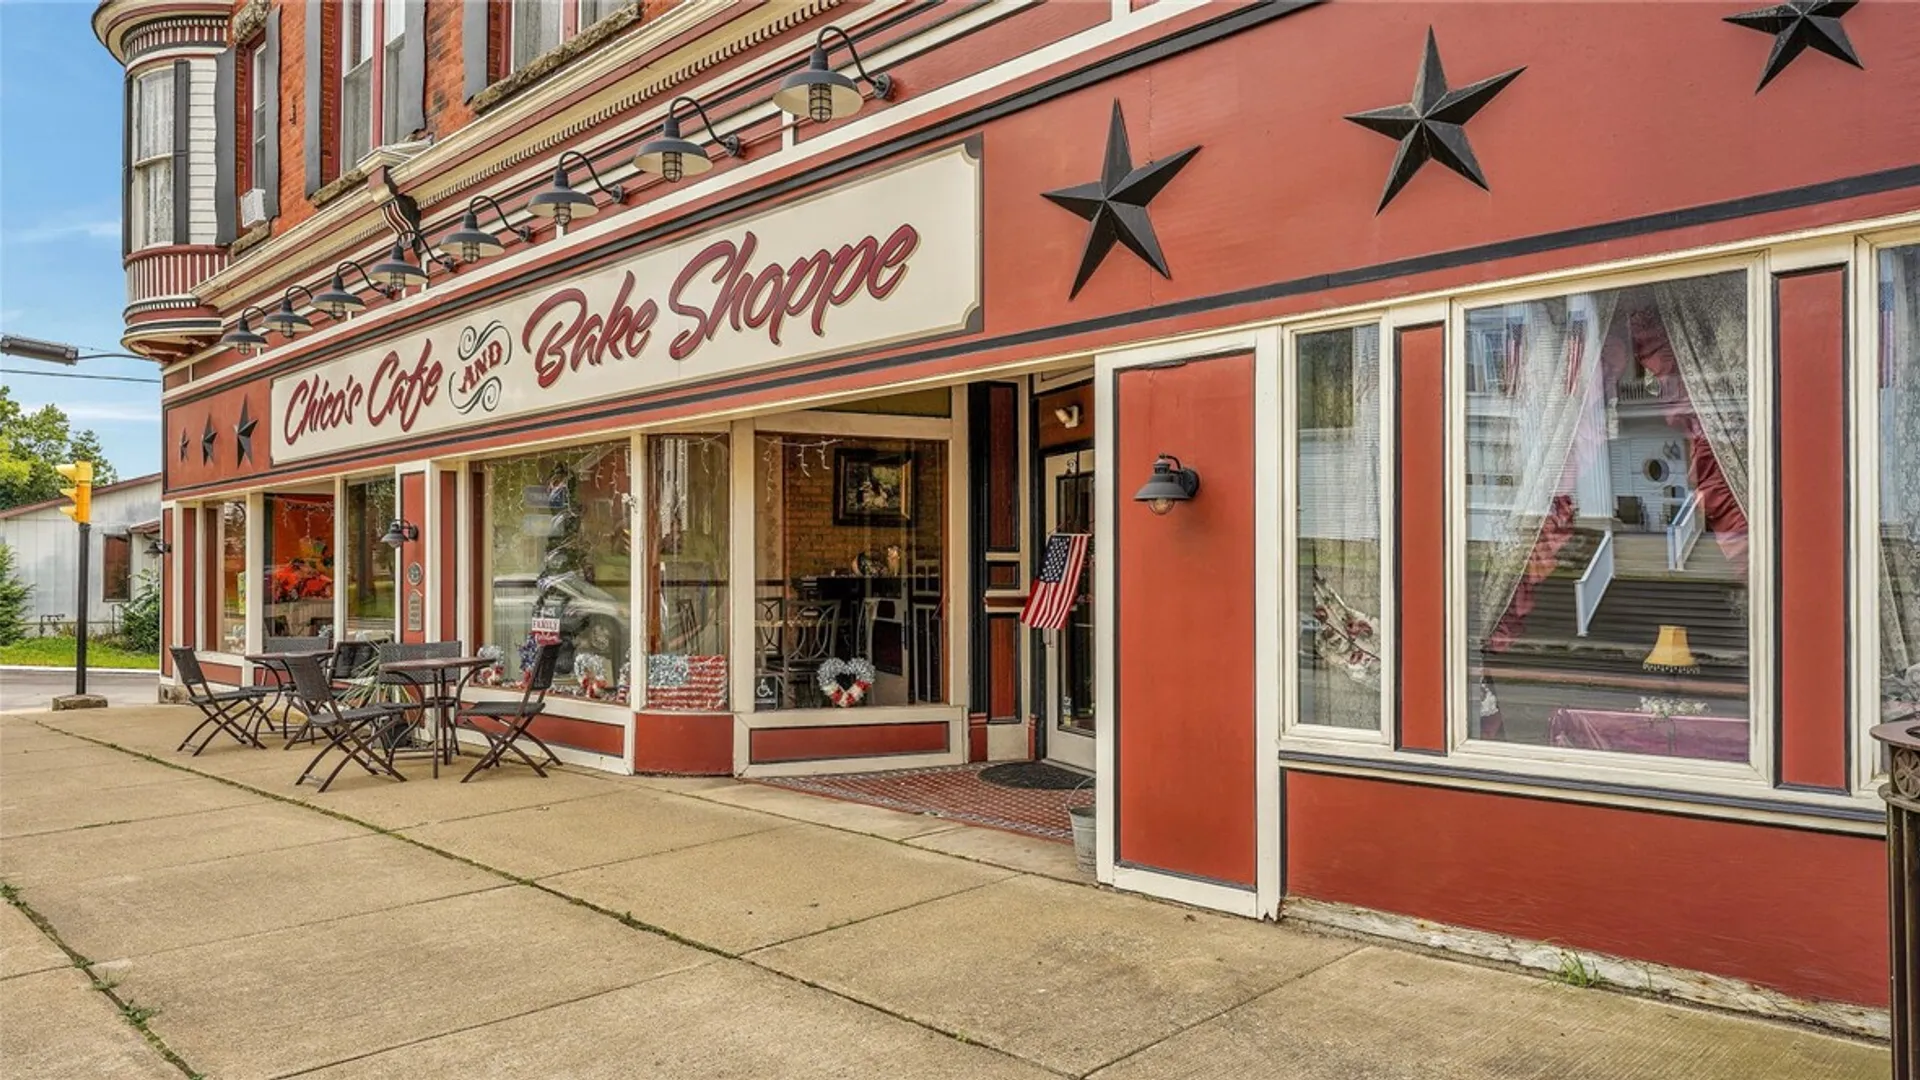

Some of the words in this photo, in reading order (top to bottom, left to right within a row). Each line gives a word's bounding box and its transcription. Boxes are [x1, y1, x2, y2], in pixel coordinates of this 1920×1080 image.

[284, 373, 364, 445] Chico's
[367, 338, 444, 432] Cafe
[457, 340, 504, 393] AND
[521, 270, 658, 389] Bake
[668, 223, 919, 361] Shoppe
